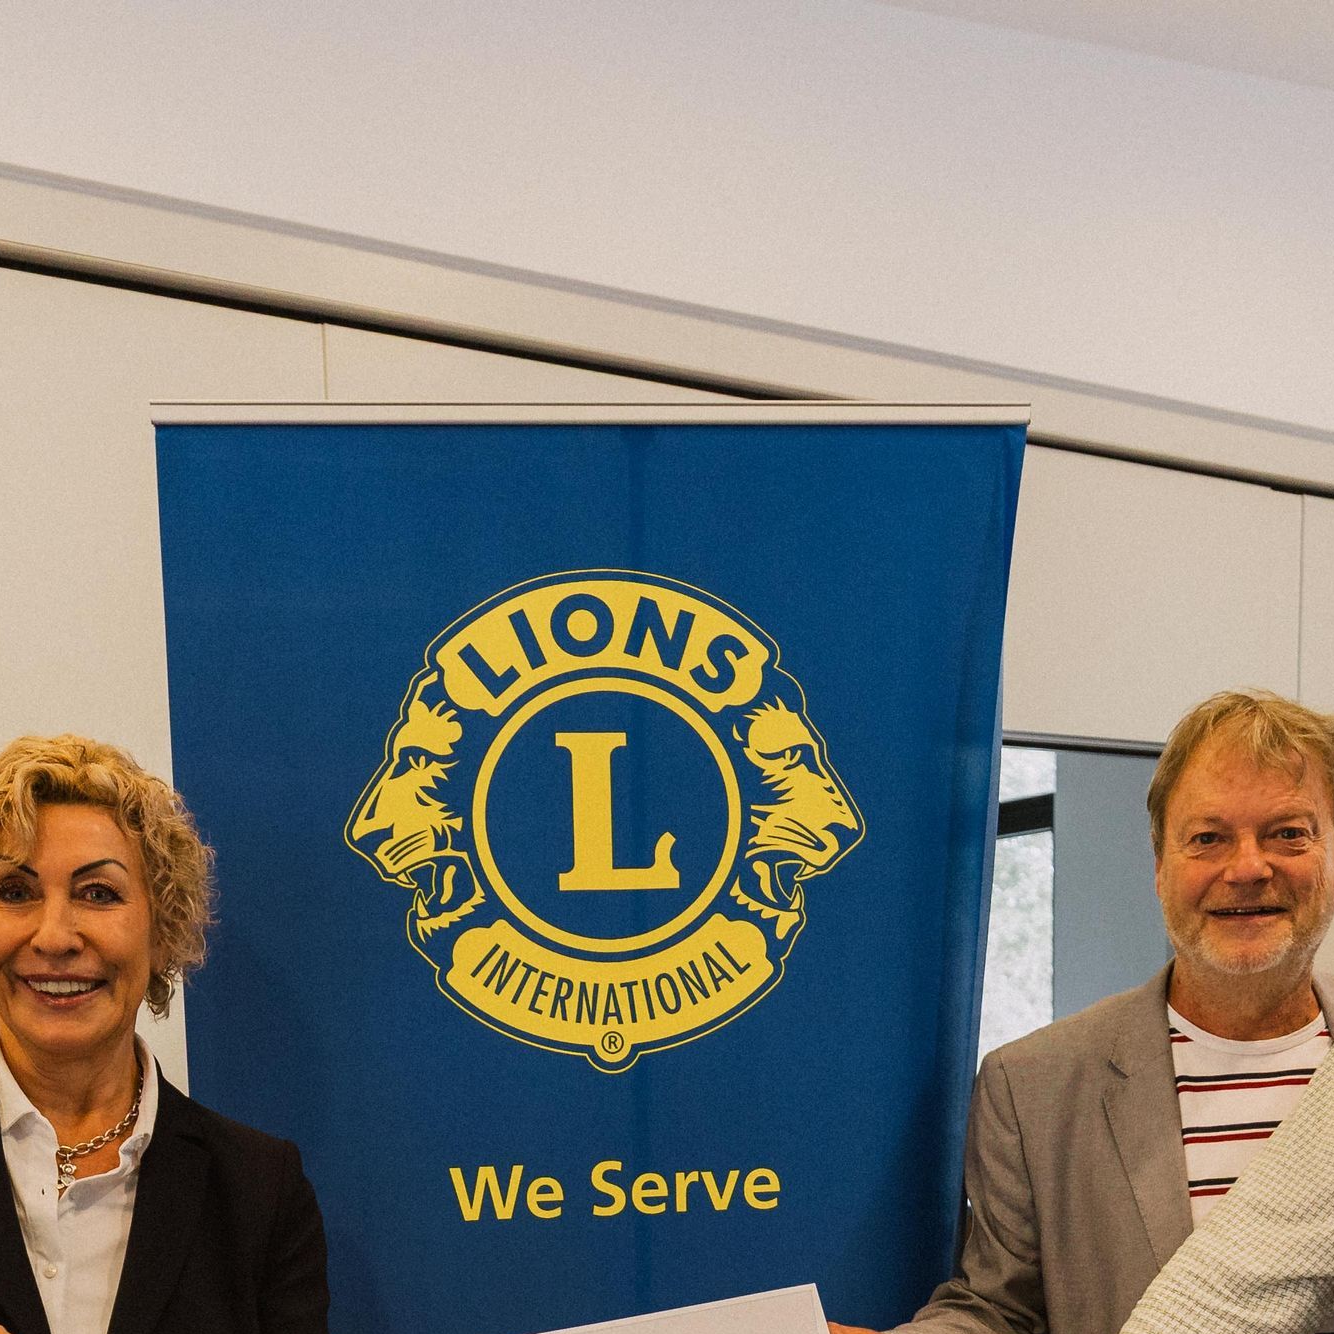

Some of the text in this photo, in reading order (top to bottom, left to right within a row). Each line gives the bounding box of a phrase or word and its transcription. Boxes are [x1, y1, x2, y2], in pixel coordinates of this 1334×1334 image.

[457, 592, 750, 700] LIONS
[554, 731, 681, 892] L
[470, 941, 752, 1026] INTERNATIONAL
[449, 1160, 782, 1221] We Serve
